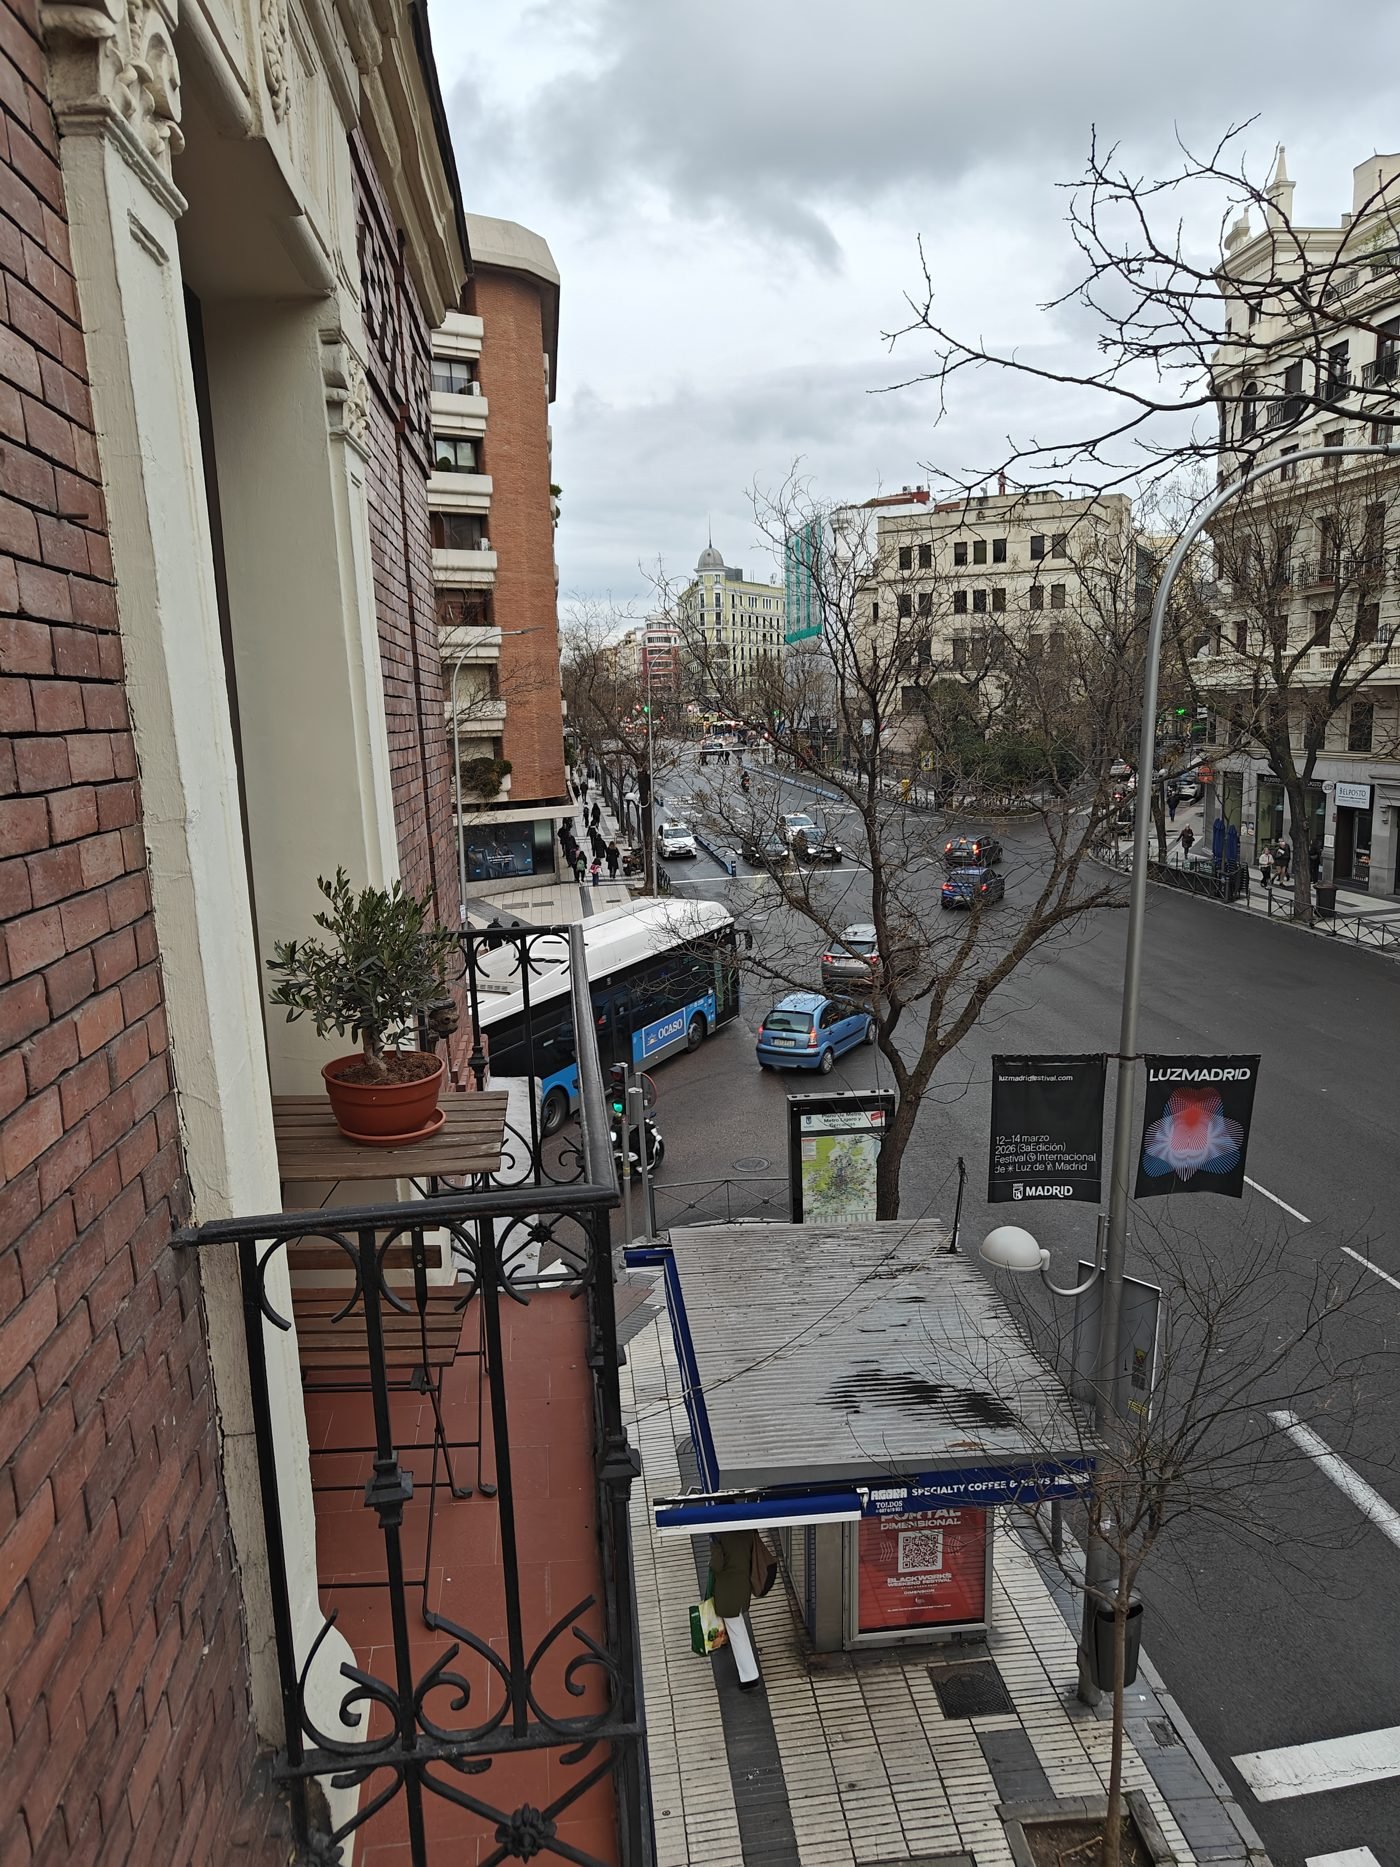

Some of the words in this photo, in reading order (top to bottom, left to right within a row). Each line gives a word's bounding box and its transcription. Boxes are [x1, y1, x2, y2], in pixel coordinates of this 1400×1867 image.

[1339, 787, 1367, 797] BELPOSTO
[658, 1018, 682, 1039] OCASO
[1149, 1068, 1251, 1081] LUZMADRID
[1021, 1134, 1050, 1143] marzo
[995, 1144, 1016, 1154] 2026
[994, 1154, 1026, 1164] Festival
[1037, 1153, 1097, 1162] Internacional
[994, 1165, 1006, 1174] de
[1016, 1163, 1032, 1172] Luz
[1033, 1162, 1045, 1171] de
[1055, 1162, 1088, 1171] Madrid
[1025, 1185, 1073, 1198] MADRID
[912, 1484, 966, 1496] SPECIALTY
[968, 1480, 1007, 1491] COFFEE
[875, 1500, 903, 1509] TOLDOS
[880, 1518, 961, 1530] DIMENSIONAL
[887, 1572, 952, 1583] BLACKWORKS
